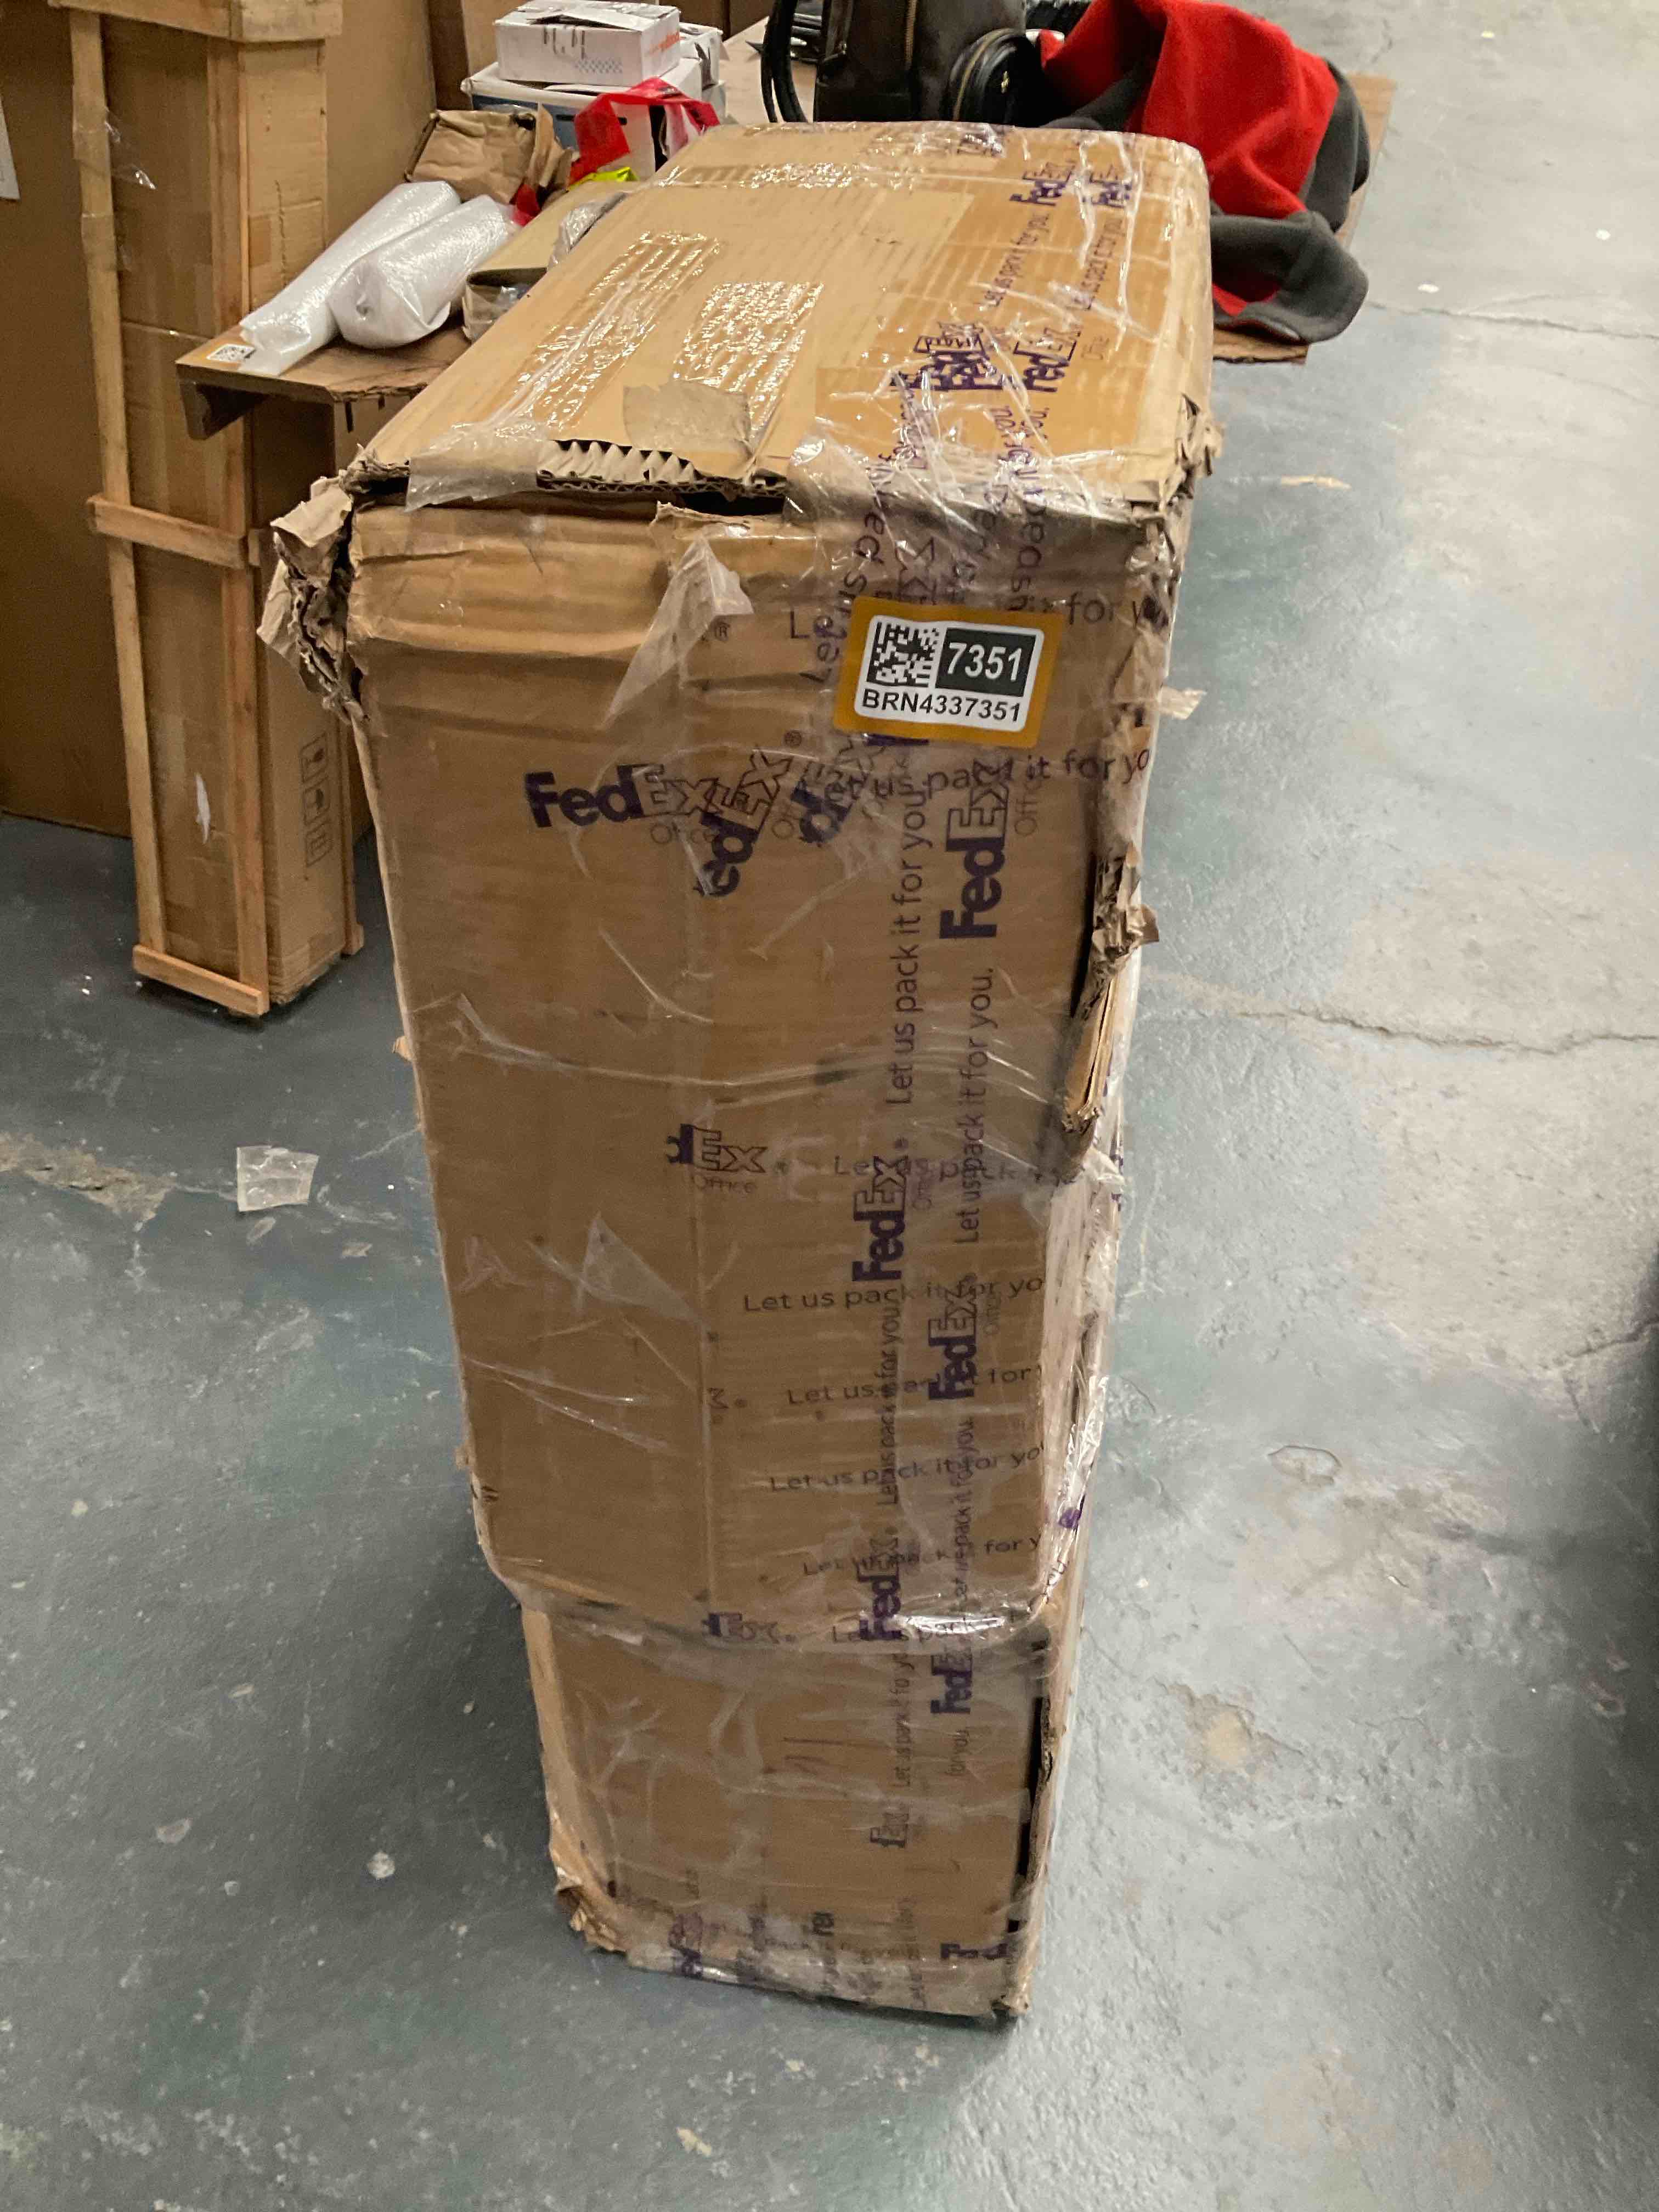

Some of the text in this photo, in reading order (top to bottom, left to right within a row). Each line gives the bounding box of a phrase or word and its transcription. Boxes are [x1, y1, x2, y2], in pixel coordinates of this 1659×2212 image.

[947, 642, 1024, 682] 7351
[862, 688, 1022, 722] BRN4337351
[939, 755, 1013, 940] FedEx
[890, 872, 922, 906] for
[890, 915, 921, 935] it
[889, 944, 924, 1015] pack
[969, 967, 998, 1032] you.
[894, 1023, 915, 1054] us
[958, 1036, 989, 1080] for
[885, 1063, 913, 1105] Let
[957, 1088, 986, 1106] it
[851, 1155, 909, 1282] FedEx
[953, 1206, 979, 1244] Let
[744, 1294, 792, 1312] Let
[802, 1292, 834, 1308] us
[844, 1282, 913, 1310] pack
[1009, 1278, 1043, 1299] yo
[788, 1385, 833, 1405] Let
[843, 1383, 874, 1400] us
[769, 1472, 811, 1492] Let
[822, 1471, 854, 1486] us
[1010, 1441, 1044, 1467] yo
